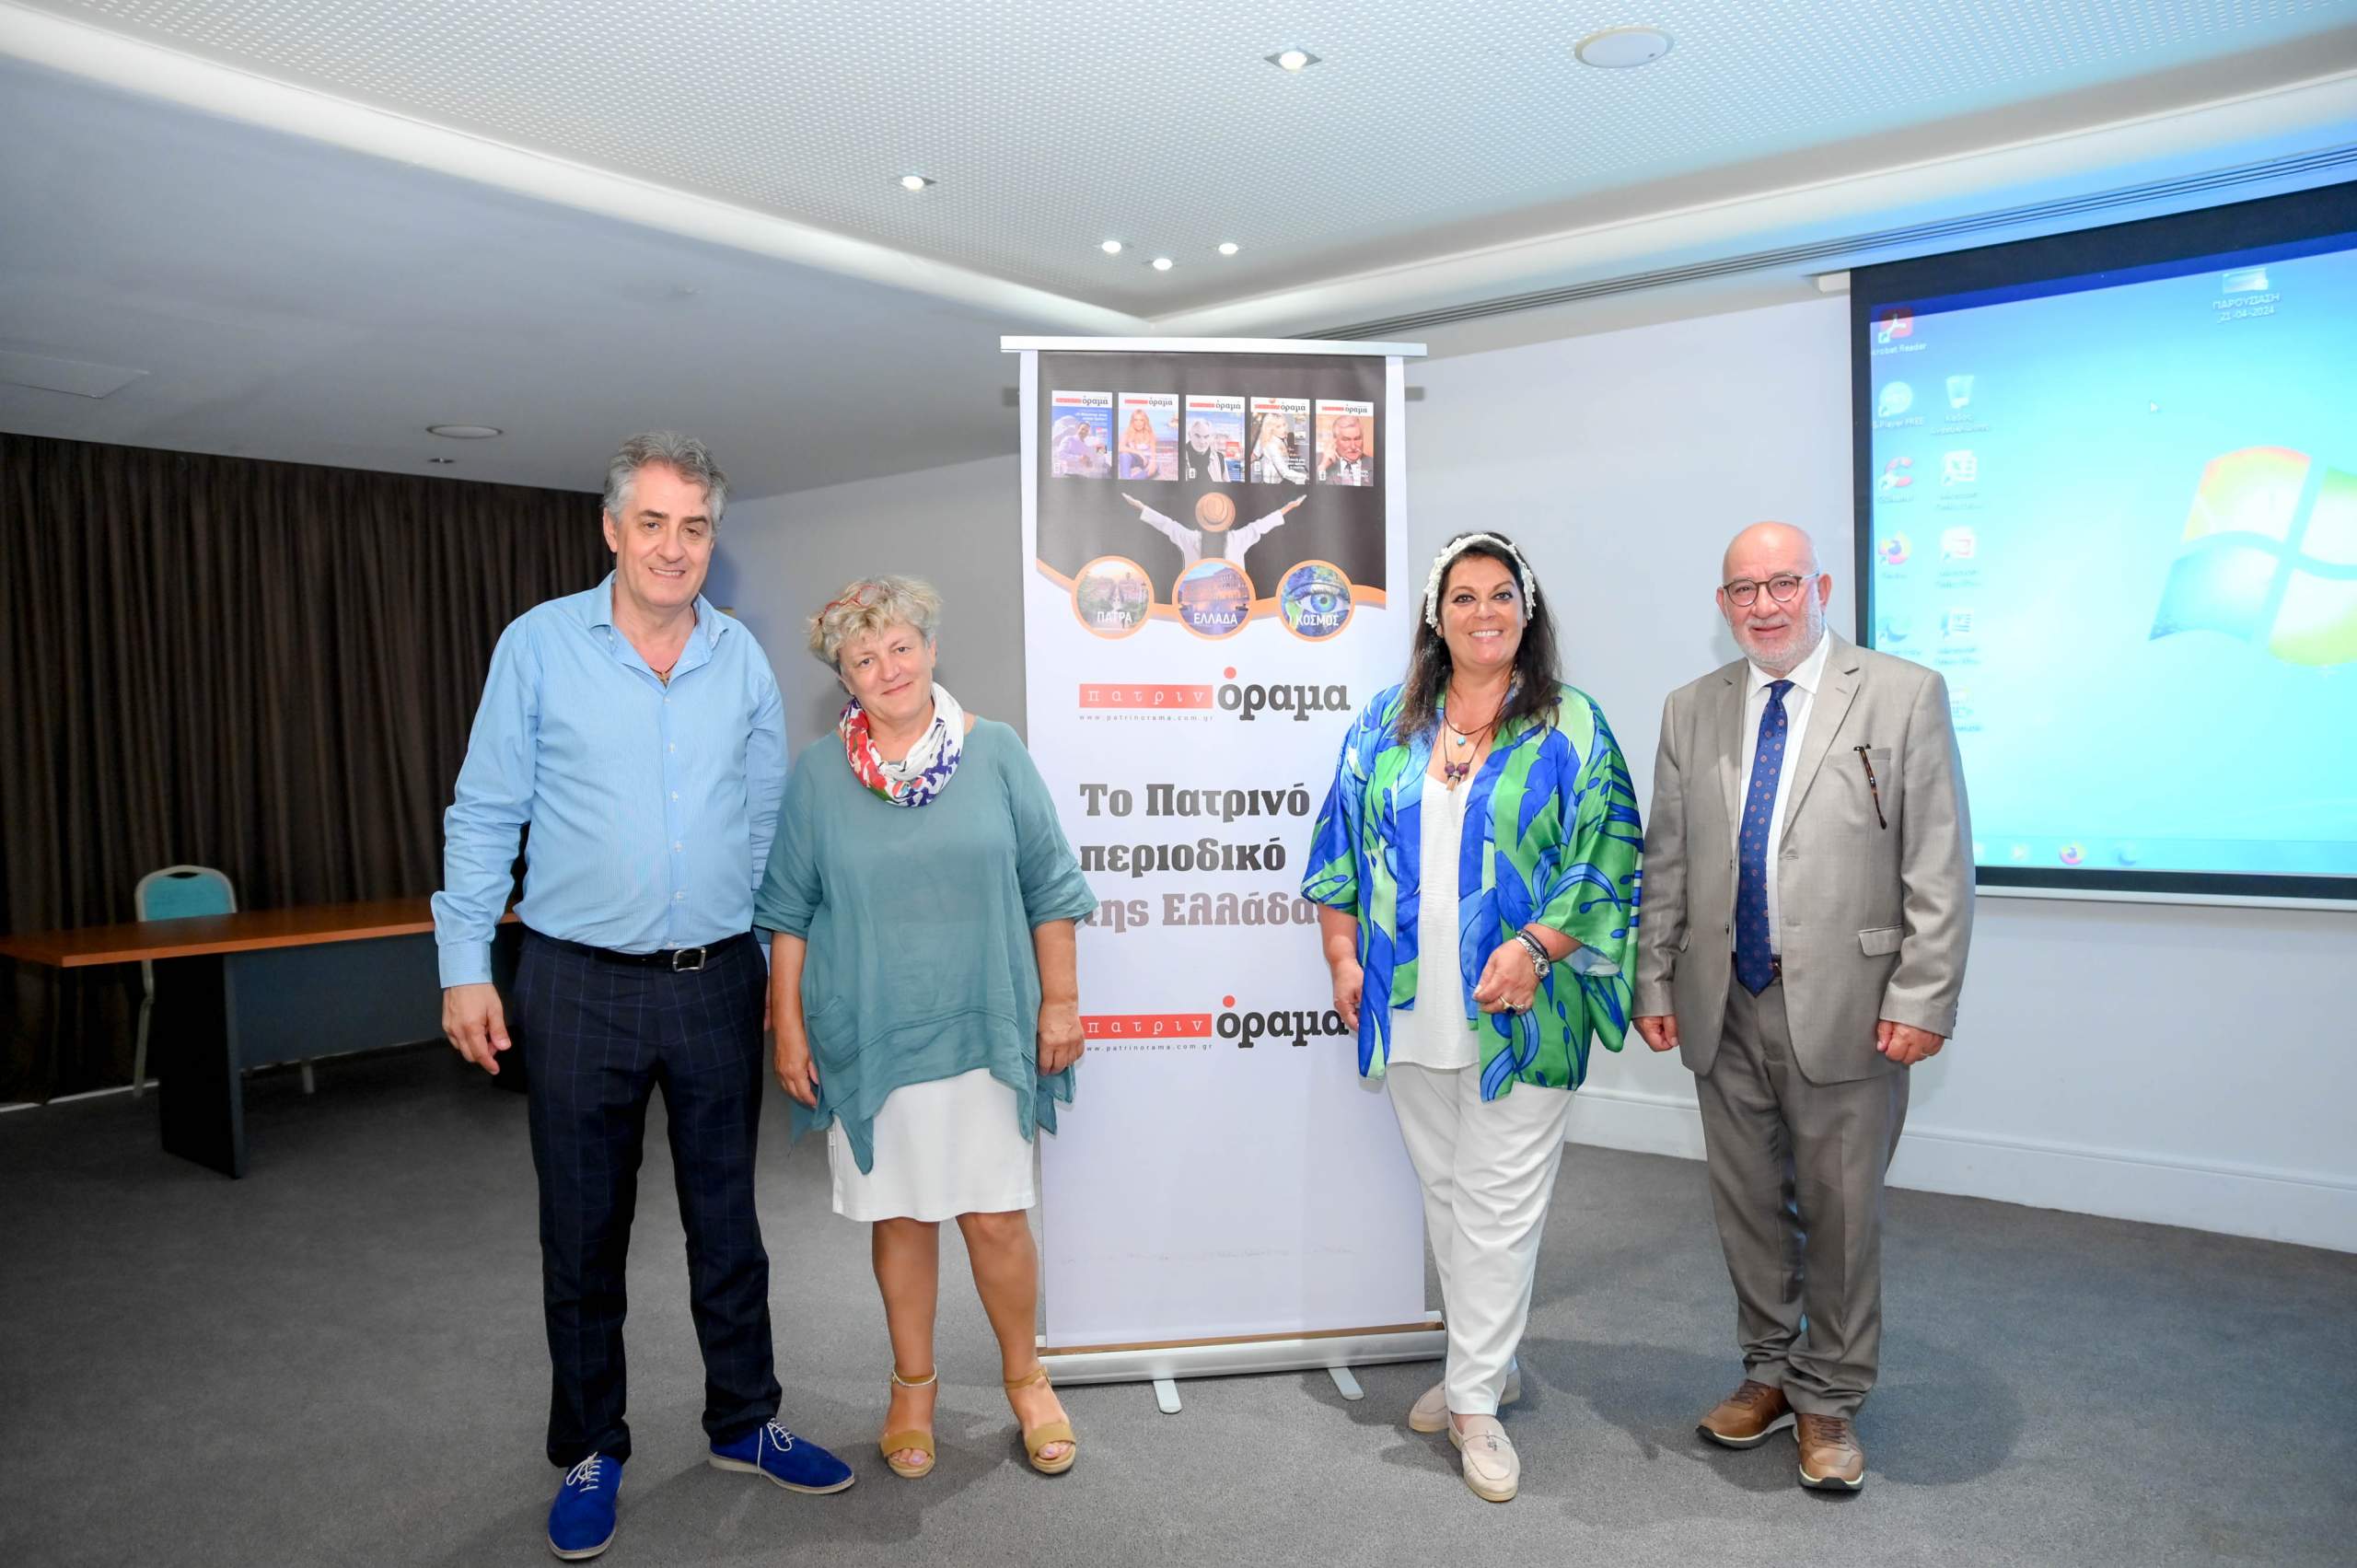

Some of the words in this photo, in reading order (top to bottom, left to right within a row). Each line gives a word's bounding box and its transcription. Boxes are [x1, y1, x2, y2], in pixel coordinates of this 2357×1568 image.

[1097, 610, 1132, 623] ΠΑΤΡΑ
[1193, 612, 1238, 625] ΕΛΛΑΔΑ
[1295, 613, 1340, 627] ΚΟΣΜΟΣ
[1079, 783, 1132, 818] Το
[1146, 783, 1310, 823] Πατρινό
[1080, 837, 1286, 878] περιοδικό
[1162, 891, 1321, 926] Ελλάδα
[1086, 1043, 1213, 1052] ww.patrinorama.com.gr
